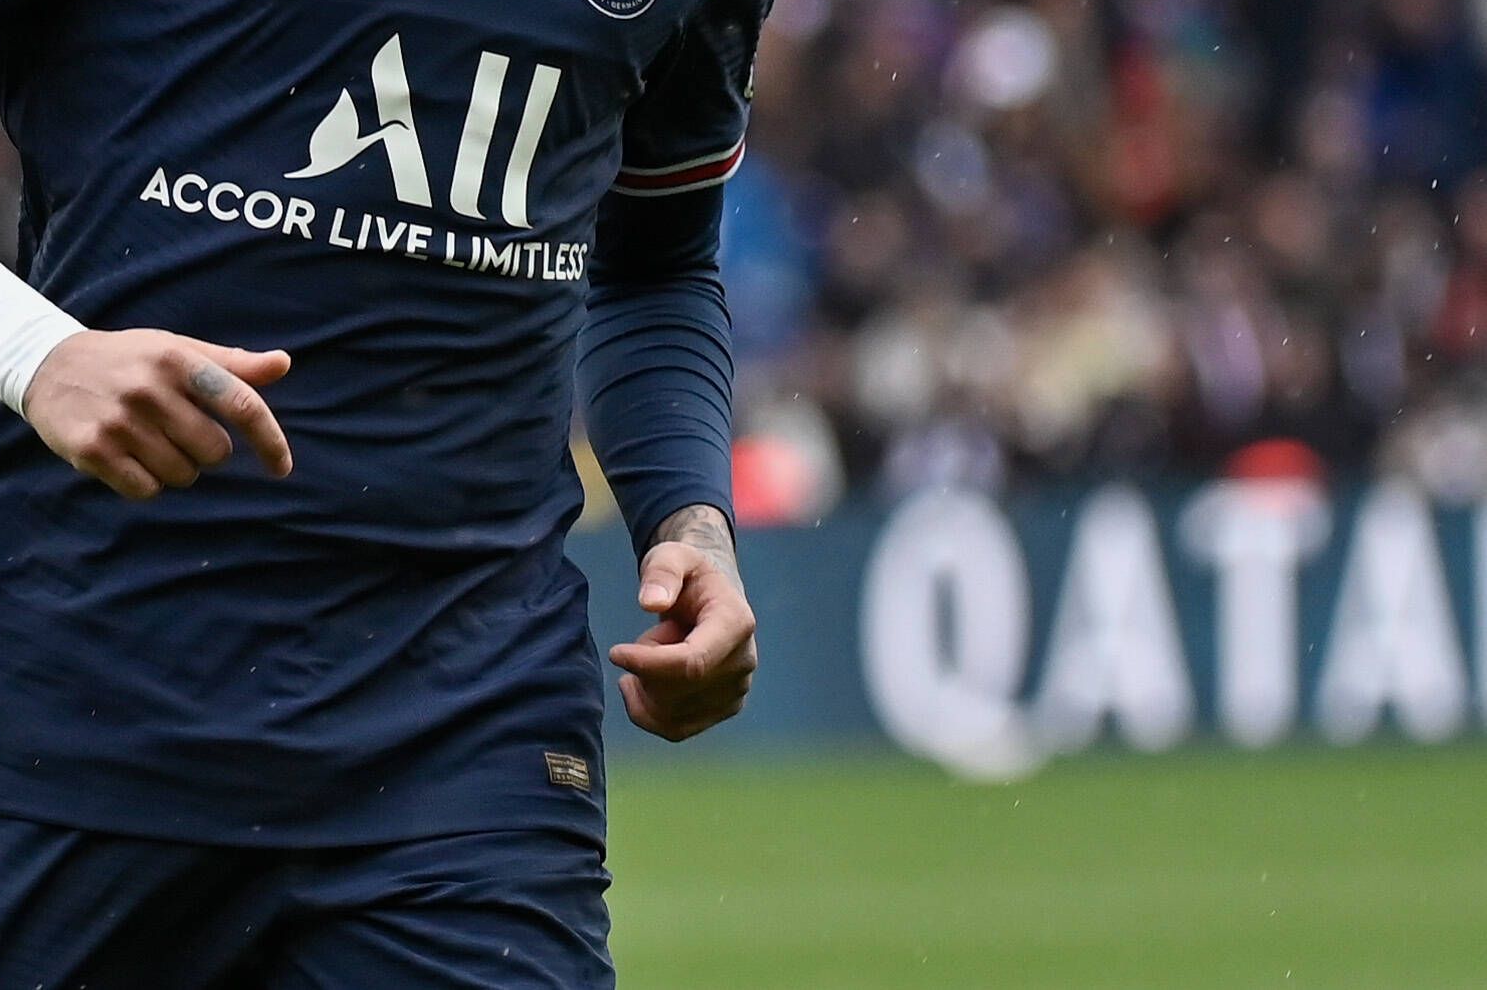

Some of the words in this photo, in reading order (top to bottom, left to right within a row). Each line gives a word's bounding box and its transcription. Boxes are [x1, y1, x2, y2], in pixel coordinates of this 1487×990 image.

[139, 166, 316, 240] ACCOR
[327, 207, 433, 260] LIVE
[443, 230, 589, 282] LIMITLESS
[858, 480, 1487, 784] QATA
